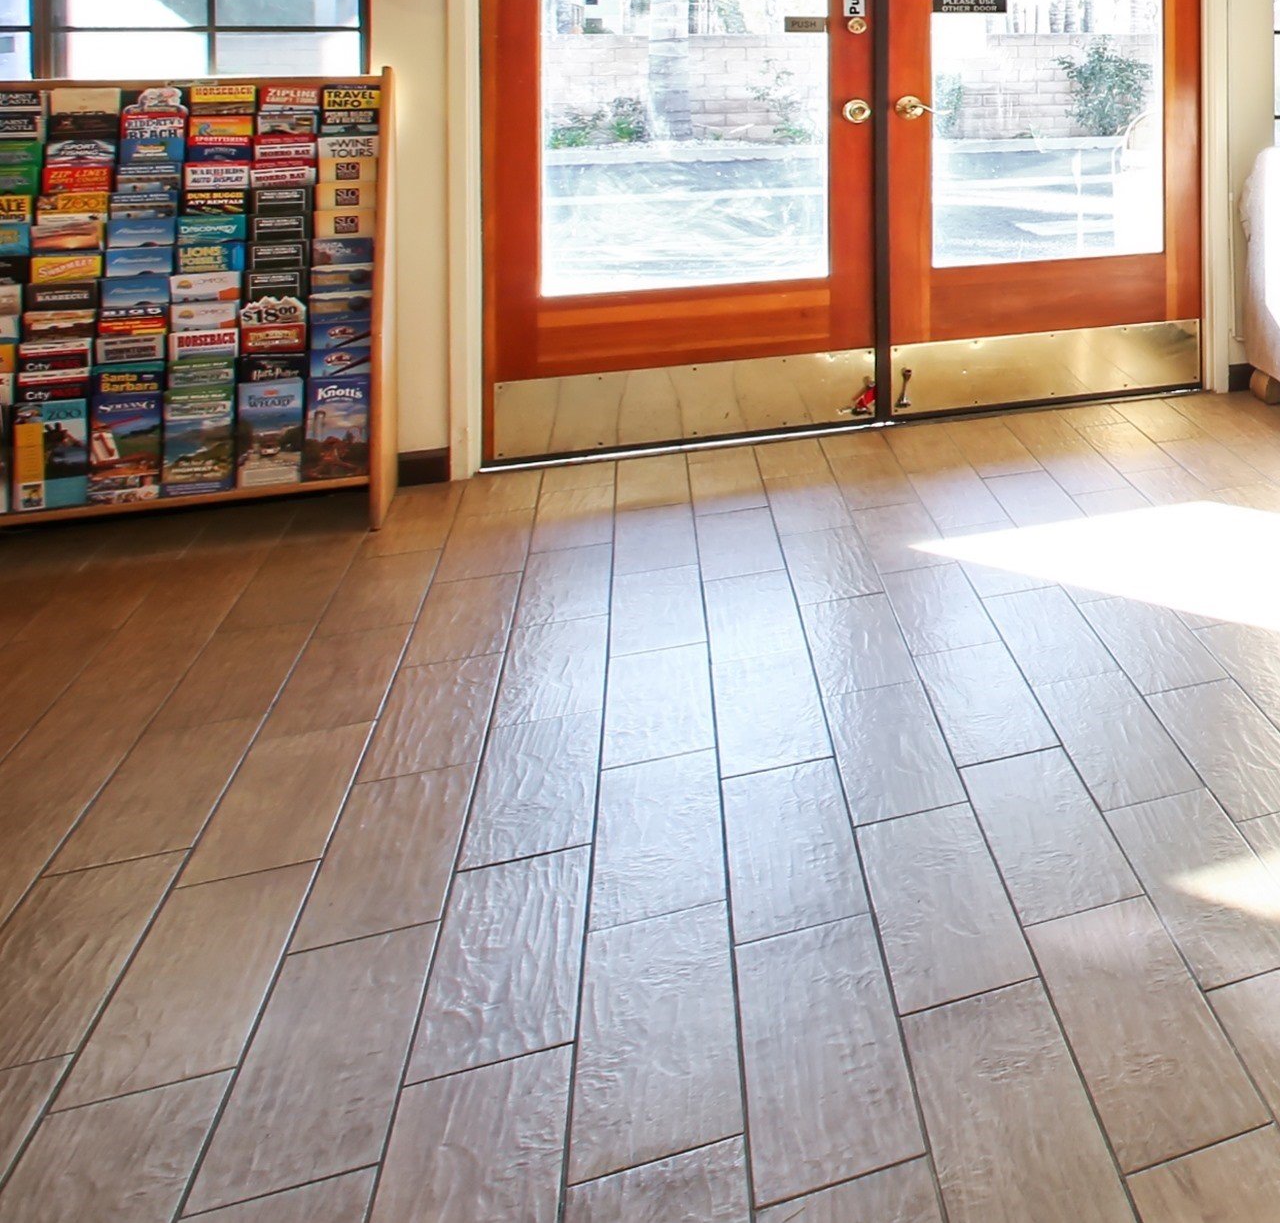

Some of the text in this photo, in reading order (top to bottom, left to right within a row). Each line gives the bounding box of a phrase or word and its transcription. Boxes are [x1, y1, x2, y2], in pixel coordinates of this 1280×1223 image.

[791, 20, 817, 28] PUSH
[326, 90, 375, 99] TRAVEL
[327, 99, 362, 108] INFO
[338, 138, 374, 147] WINE
[330, 148, 374, 158] TOURS
[61, 198, 101, 210] ZOO
[177, 331, 236, 348] HORSEBACK
[101, 373, 138, 382] Santa
[101, 381, 159, 392] Barbara
[317, 385, 363, 401] Knott's
[48, 409, 82, 420] ZOO
